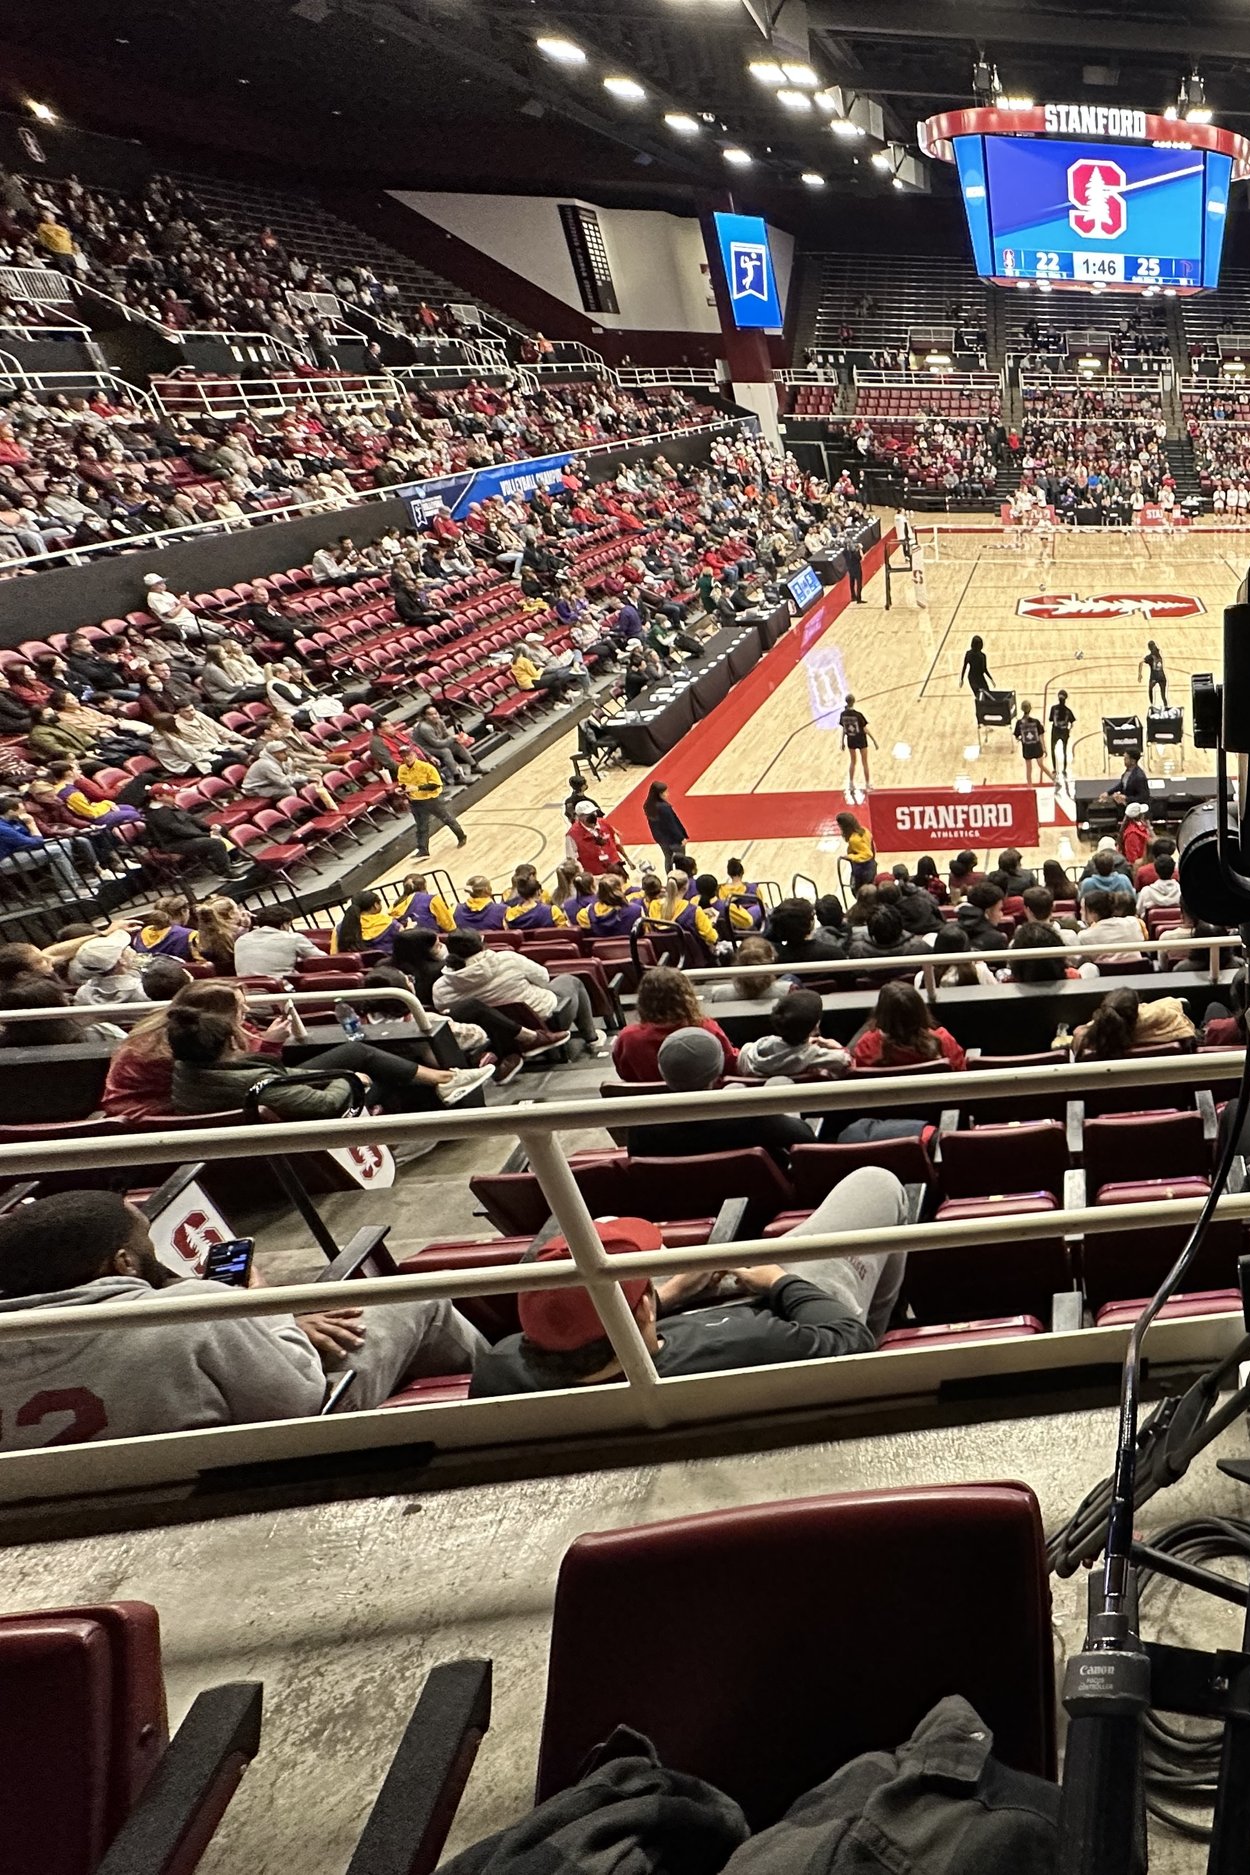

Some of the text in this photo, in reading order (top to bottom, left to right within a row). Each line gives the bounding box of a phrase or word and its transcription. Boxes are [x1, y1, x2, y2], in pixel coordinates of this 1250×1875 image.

[1045, 104, 1146, 138] STANFORD
[1036, 252, 1060, 271] 22
[1082, 259, 1116, 275] 1:46
[1137, 257, 1160, 276] 25
[499, 474, 538, 497] VOLLEYBALL
[896, 804, 1012, 830] STANFORD
[930, 830, 980, 838] ATHLETICS
[0, 1386, 109, 1447] 2
[1079, 1665, 1114, 1675] Canon
